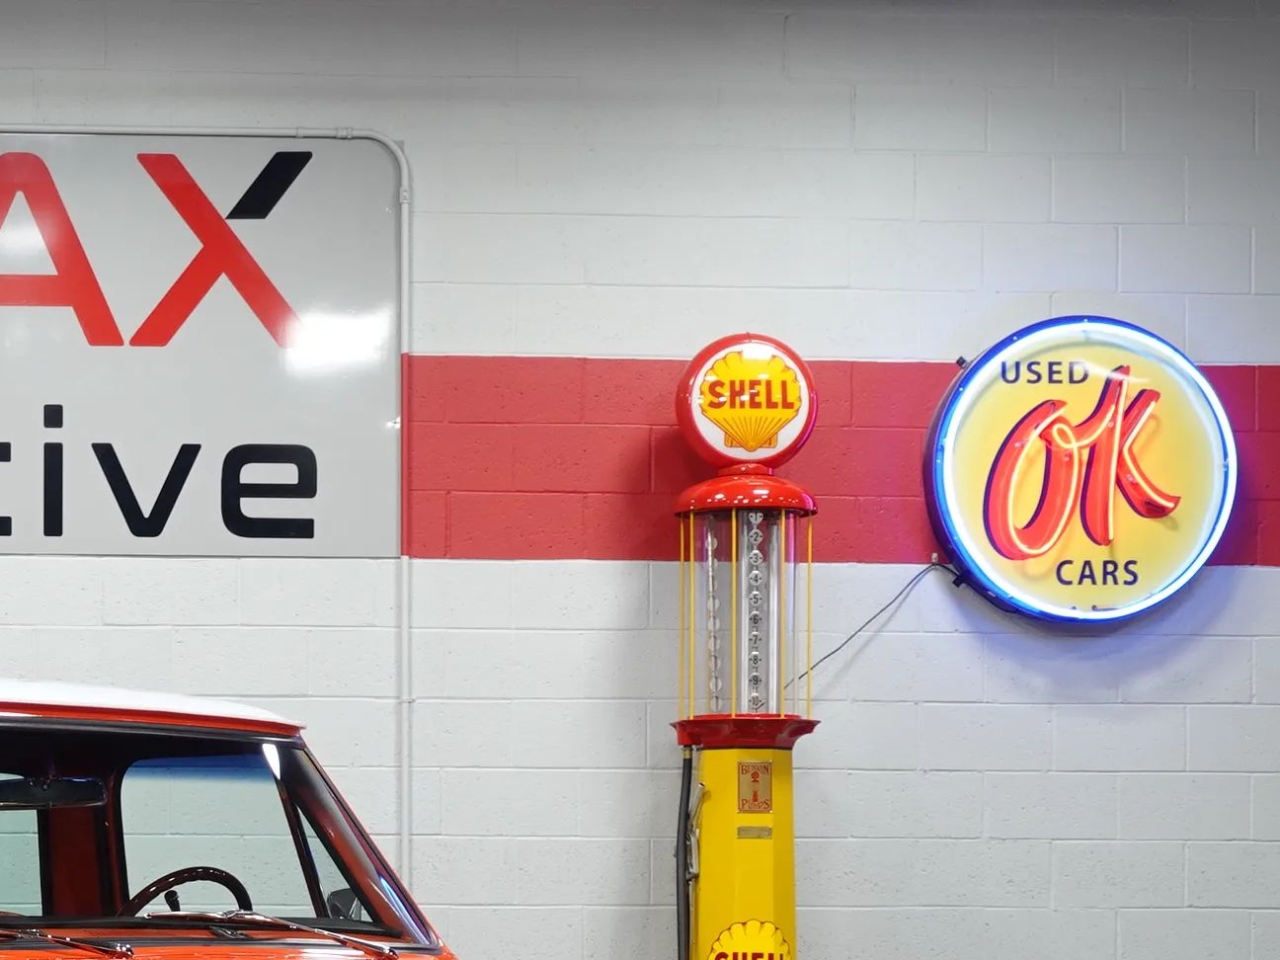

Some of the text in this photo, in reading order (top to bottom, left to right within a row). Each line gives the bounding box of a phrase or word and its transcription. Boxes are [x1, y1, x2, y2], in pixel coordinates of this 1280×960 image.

[1000, 360, 1090, 385] USED
[707, 379, 795, 410] SHELL
[982, 364, 1182, 561] OK
[1055, 560, 1140, 586] CARS
